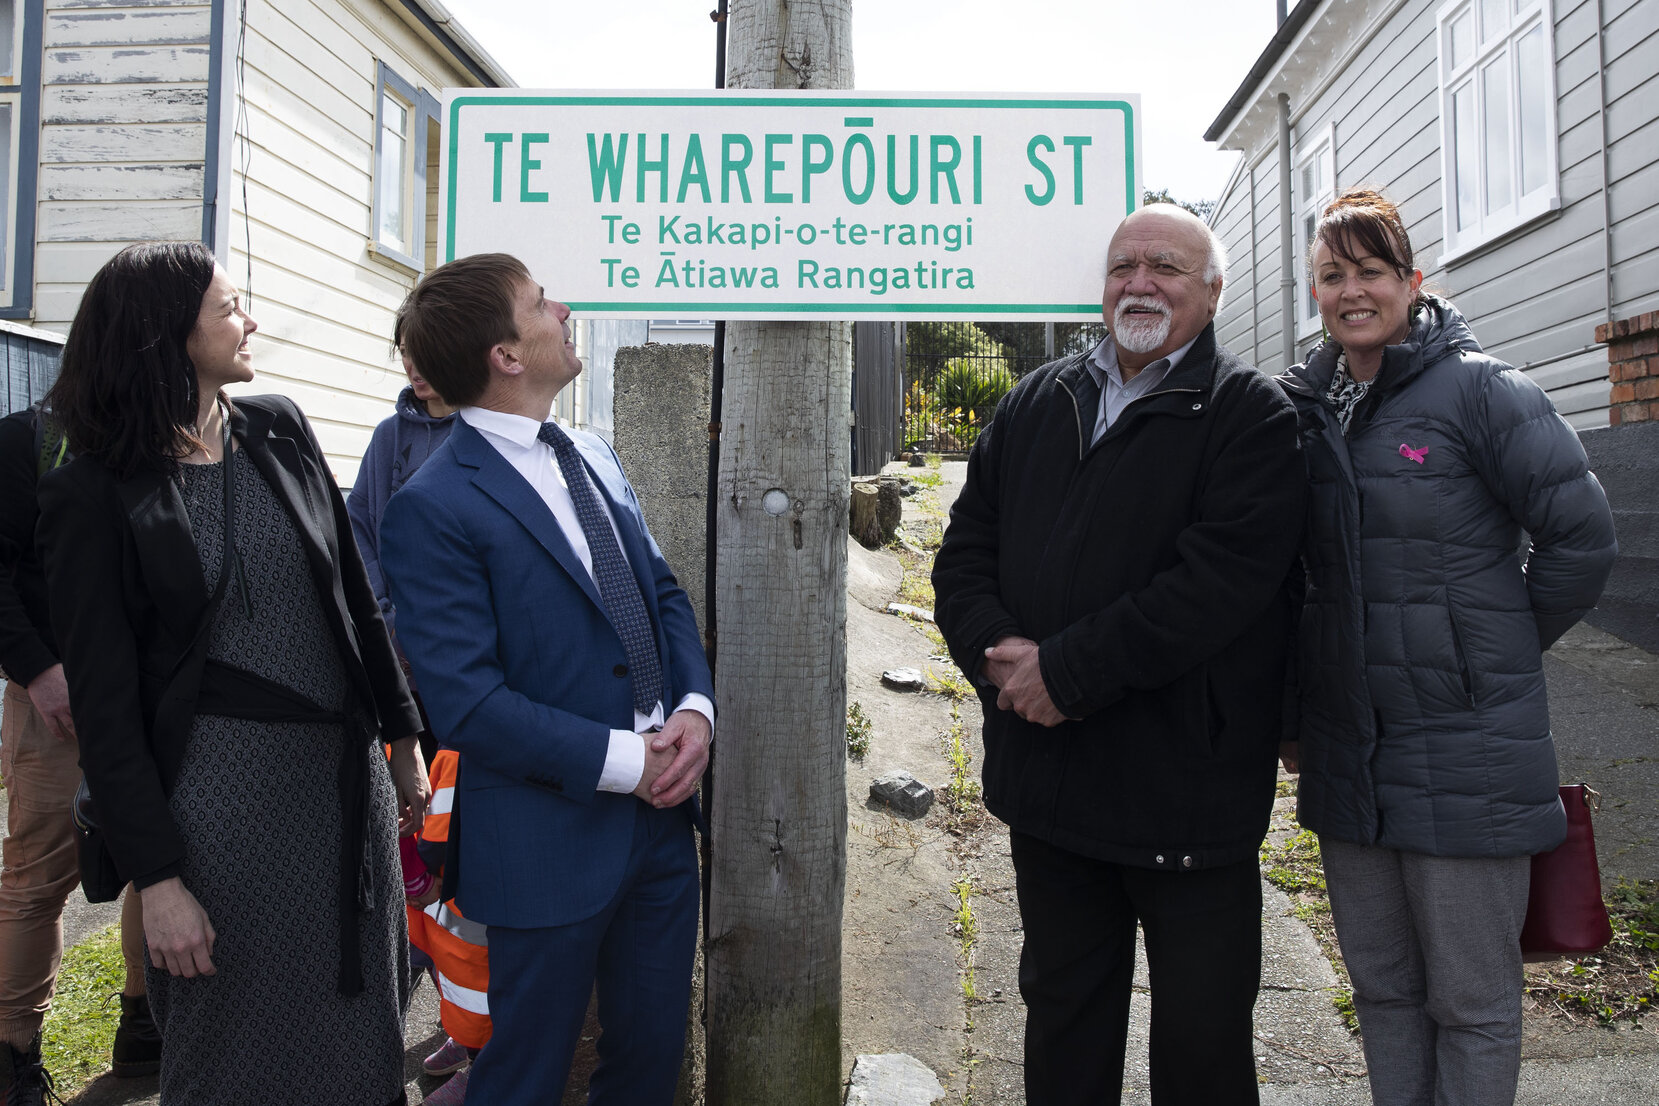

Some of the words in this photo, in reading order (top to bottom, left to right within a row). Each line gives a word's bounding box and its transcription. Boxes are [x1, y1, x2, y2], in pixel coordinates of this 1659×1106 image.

[484, 132, 550, 203] TE
[585, 116, 983, 206] WHAREPŌURI
[1024, 133, 1093, 207] ST
[600, 215, 641, 245] Te
[658, 215, 973, 252] Kakapi-o-te-rangi
[599, 258, 641, 289] Te
[655, 251, 779, 289] Ātiawa
[797, 259, 975, 296] Rangatira
